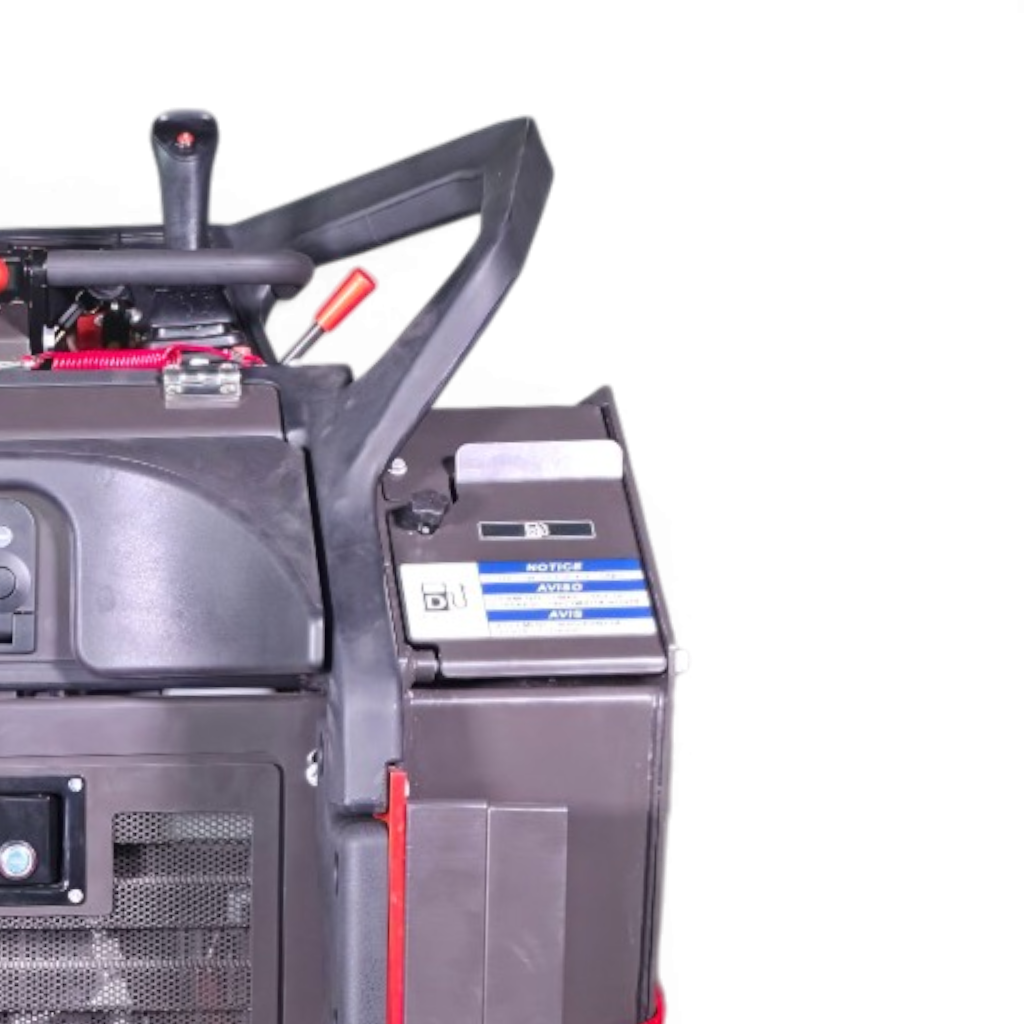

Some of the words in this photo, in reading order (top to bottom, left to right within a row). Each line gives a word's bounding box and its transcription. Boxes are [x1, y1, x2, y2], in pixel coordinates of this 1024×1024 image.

[526, 561, 583, 572] NOTICE
[537, 582, 583, 593] AVISO
[426, 595, 446, 609] D
[548, 609, 583, 620] AVIS
